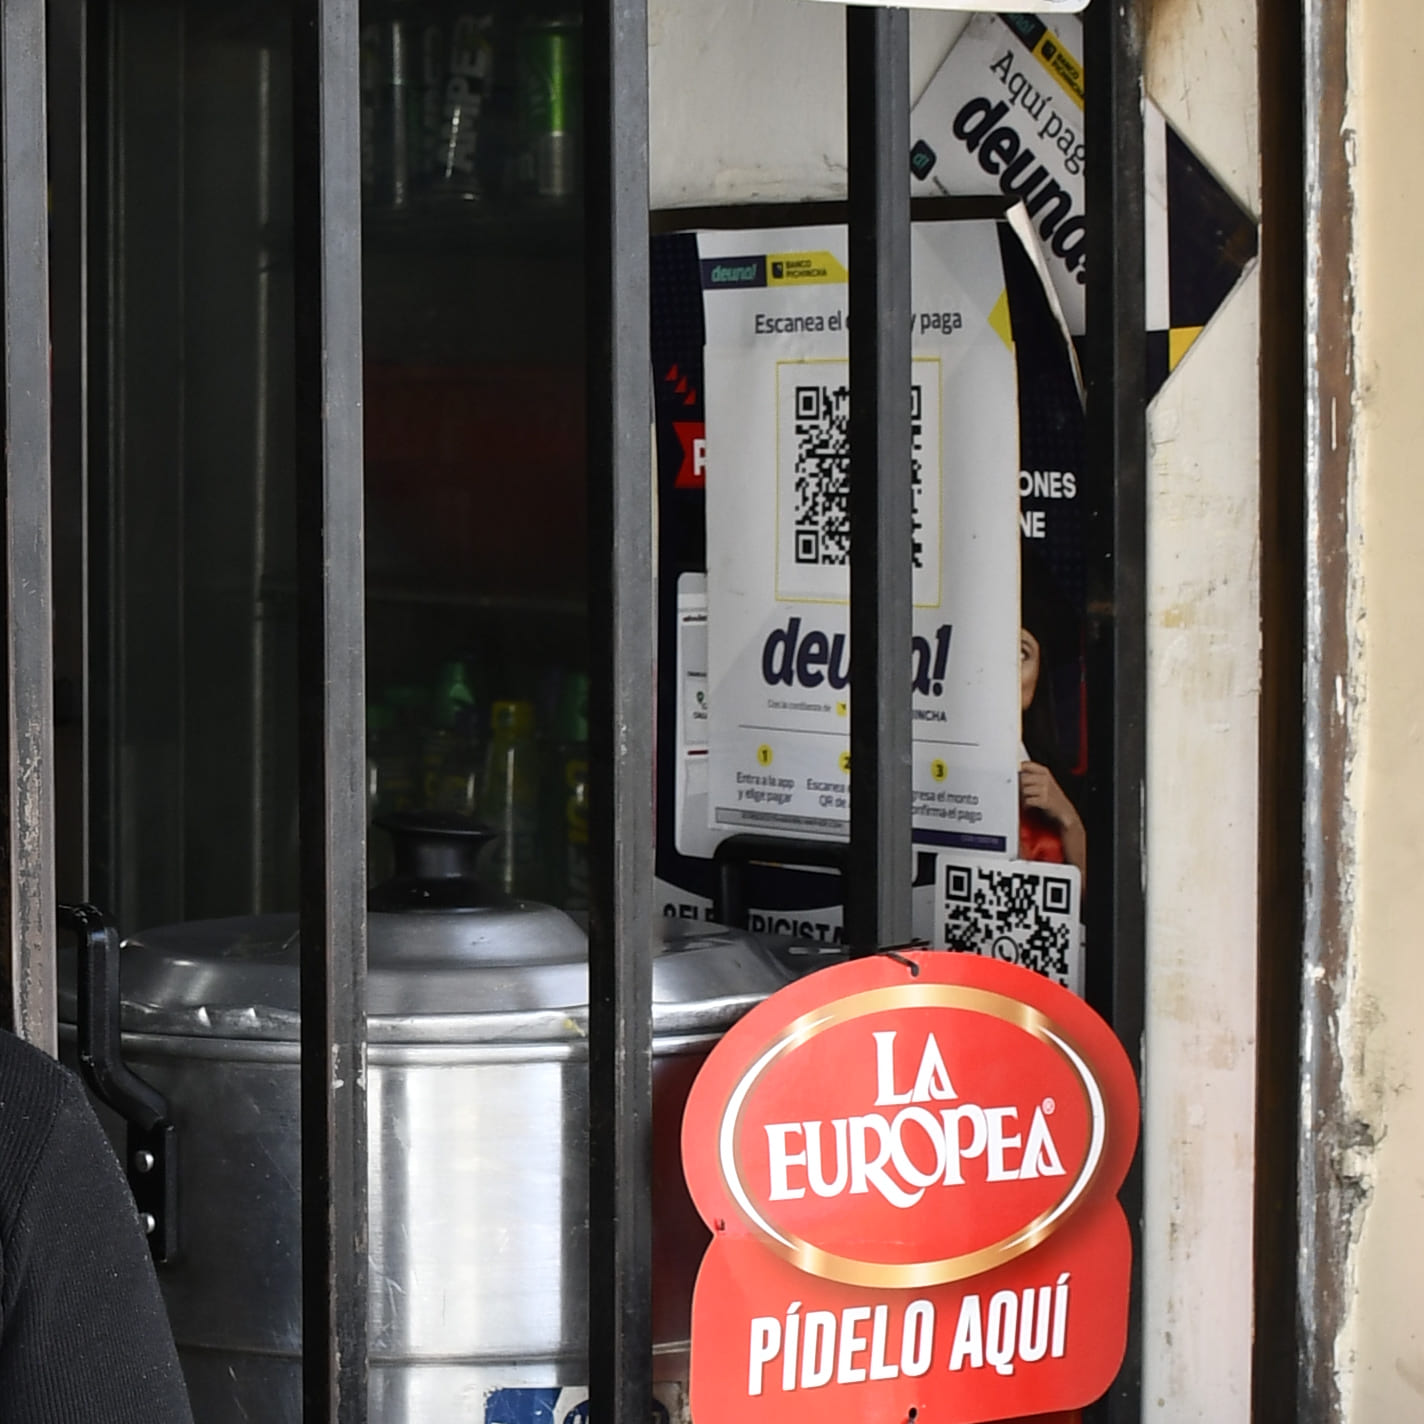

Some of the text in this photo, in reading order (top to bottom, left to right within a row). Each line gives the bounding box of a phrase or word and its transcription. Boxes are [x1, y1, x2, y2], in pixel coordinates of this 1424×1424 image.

[990, 50, 1053, 121] Aquí
[1038, 111, 1086, 175] pag
[755, 309, 963, 336] Escanea el paga
[1019, 470, 1077, 499] ONES
[761, 749, 769, 763] 1
[806, 778, 846, 794] Escanea
[872, 1031, 958, 1107] LA
[764, 1103, 1066, 1209] EUROPEA
[748, 1272, 1071, 1397] PÍDELO AQUÍ
